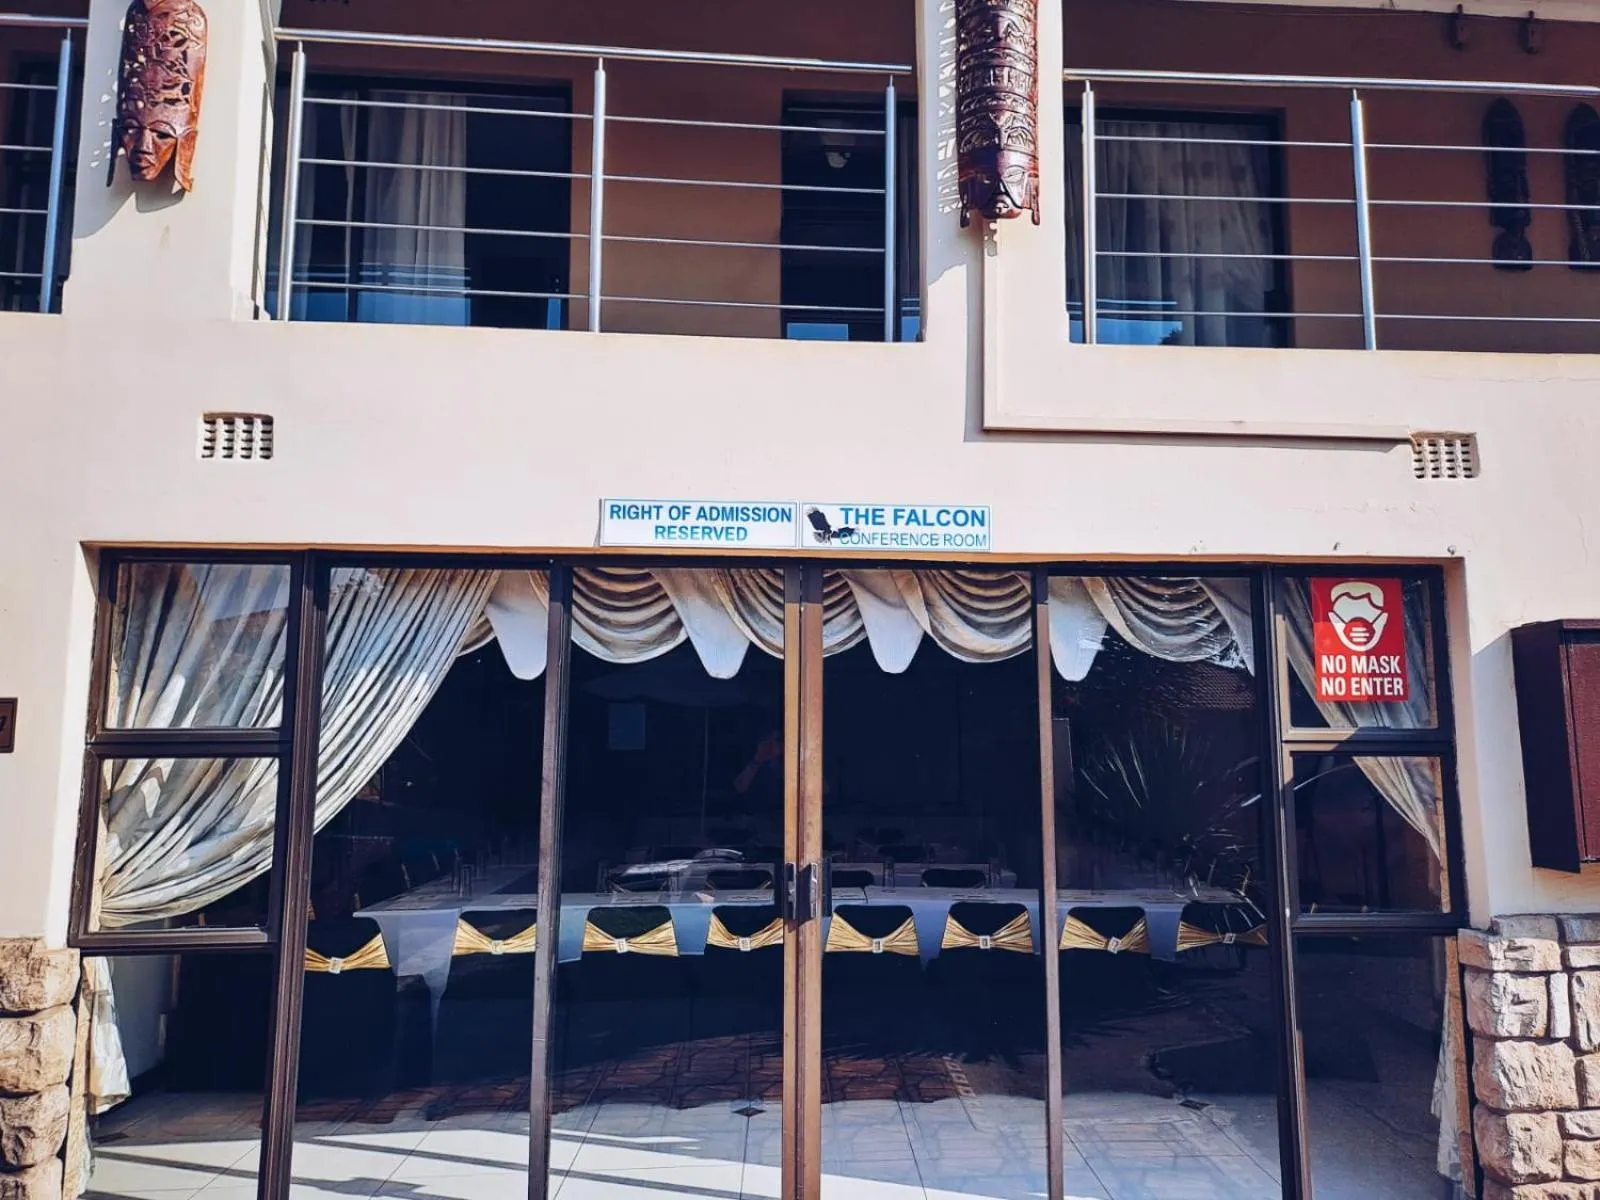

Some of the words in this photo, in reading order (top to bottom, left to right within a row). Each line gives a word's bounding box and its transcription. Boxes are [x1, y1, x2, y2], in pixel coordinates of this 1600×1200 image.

[609, 504, 663, 521] RIGHT
[668, 505, 692, 521] OF
[695, 506, 792, 523] ADMISSION
[840, 507, 885, 526] THE
[893, 508, 985, 527] FALCON
[654, 525, 748, 541] RESERVED
[840, 532, 939, 546] CONFERENCE
[943, 534, 987, 547] ROOM
[1321, 654, 1347, 674] NO
[1351, 655, 1401, 674] MASK
[1321, 677, 1346, 696] NO
[1351, 677, 1404, 696] ENTER
